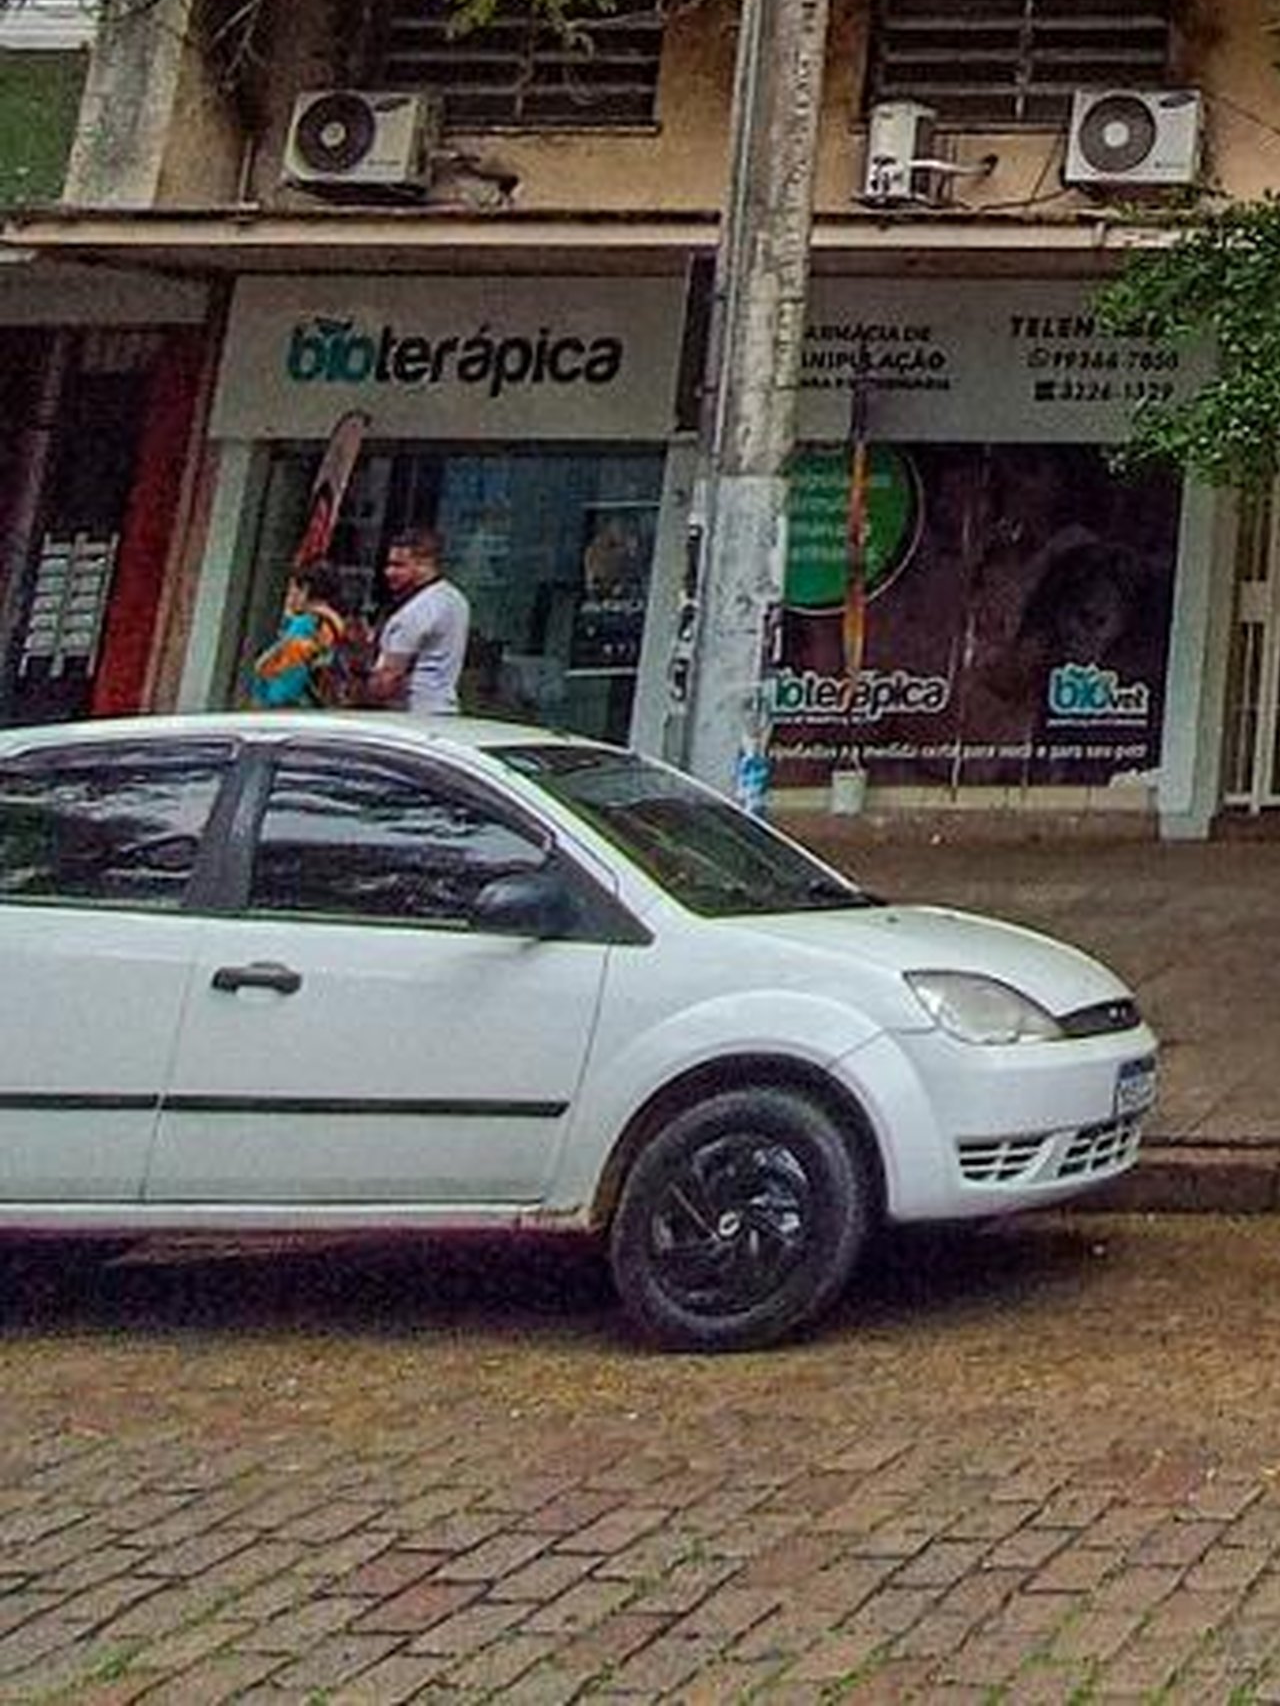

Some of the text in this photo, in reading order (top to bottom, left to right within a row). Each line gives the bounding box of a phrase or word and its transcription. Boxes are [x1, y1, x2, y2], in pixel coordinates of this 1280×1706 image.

[287, 317, 625, 398] bioterápica
[803, 323, 899, 342] ARMÁCIA
[773, 667, 949, 720] ioterápica
